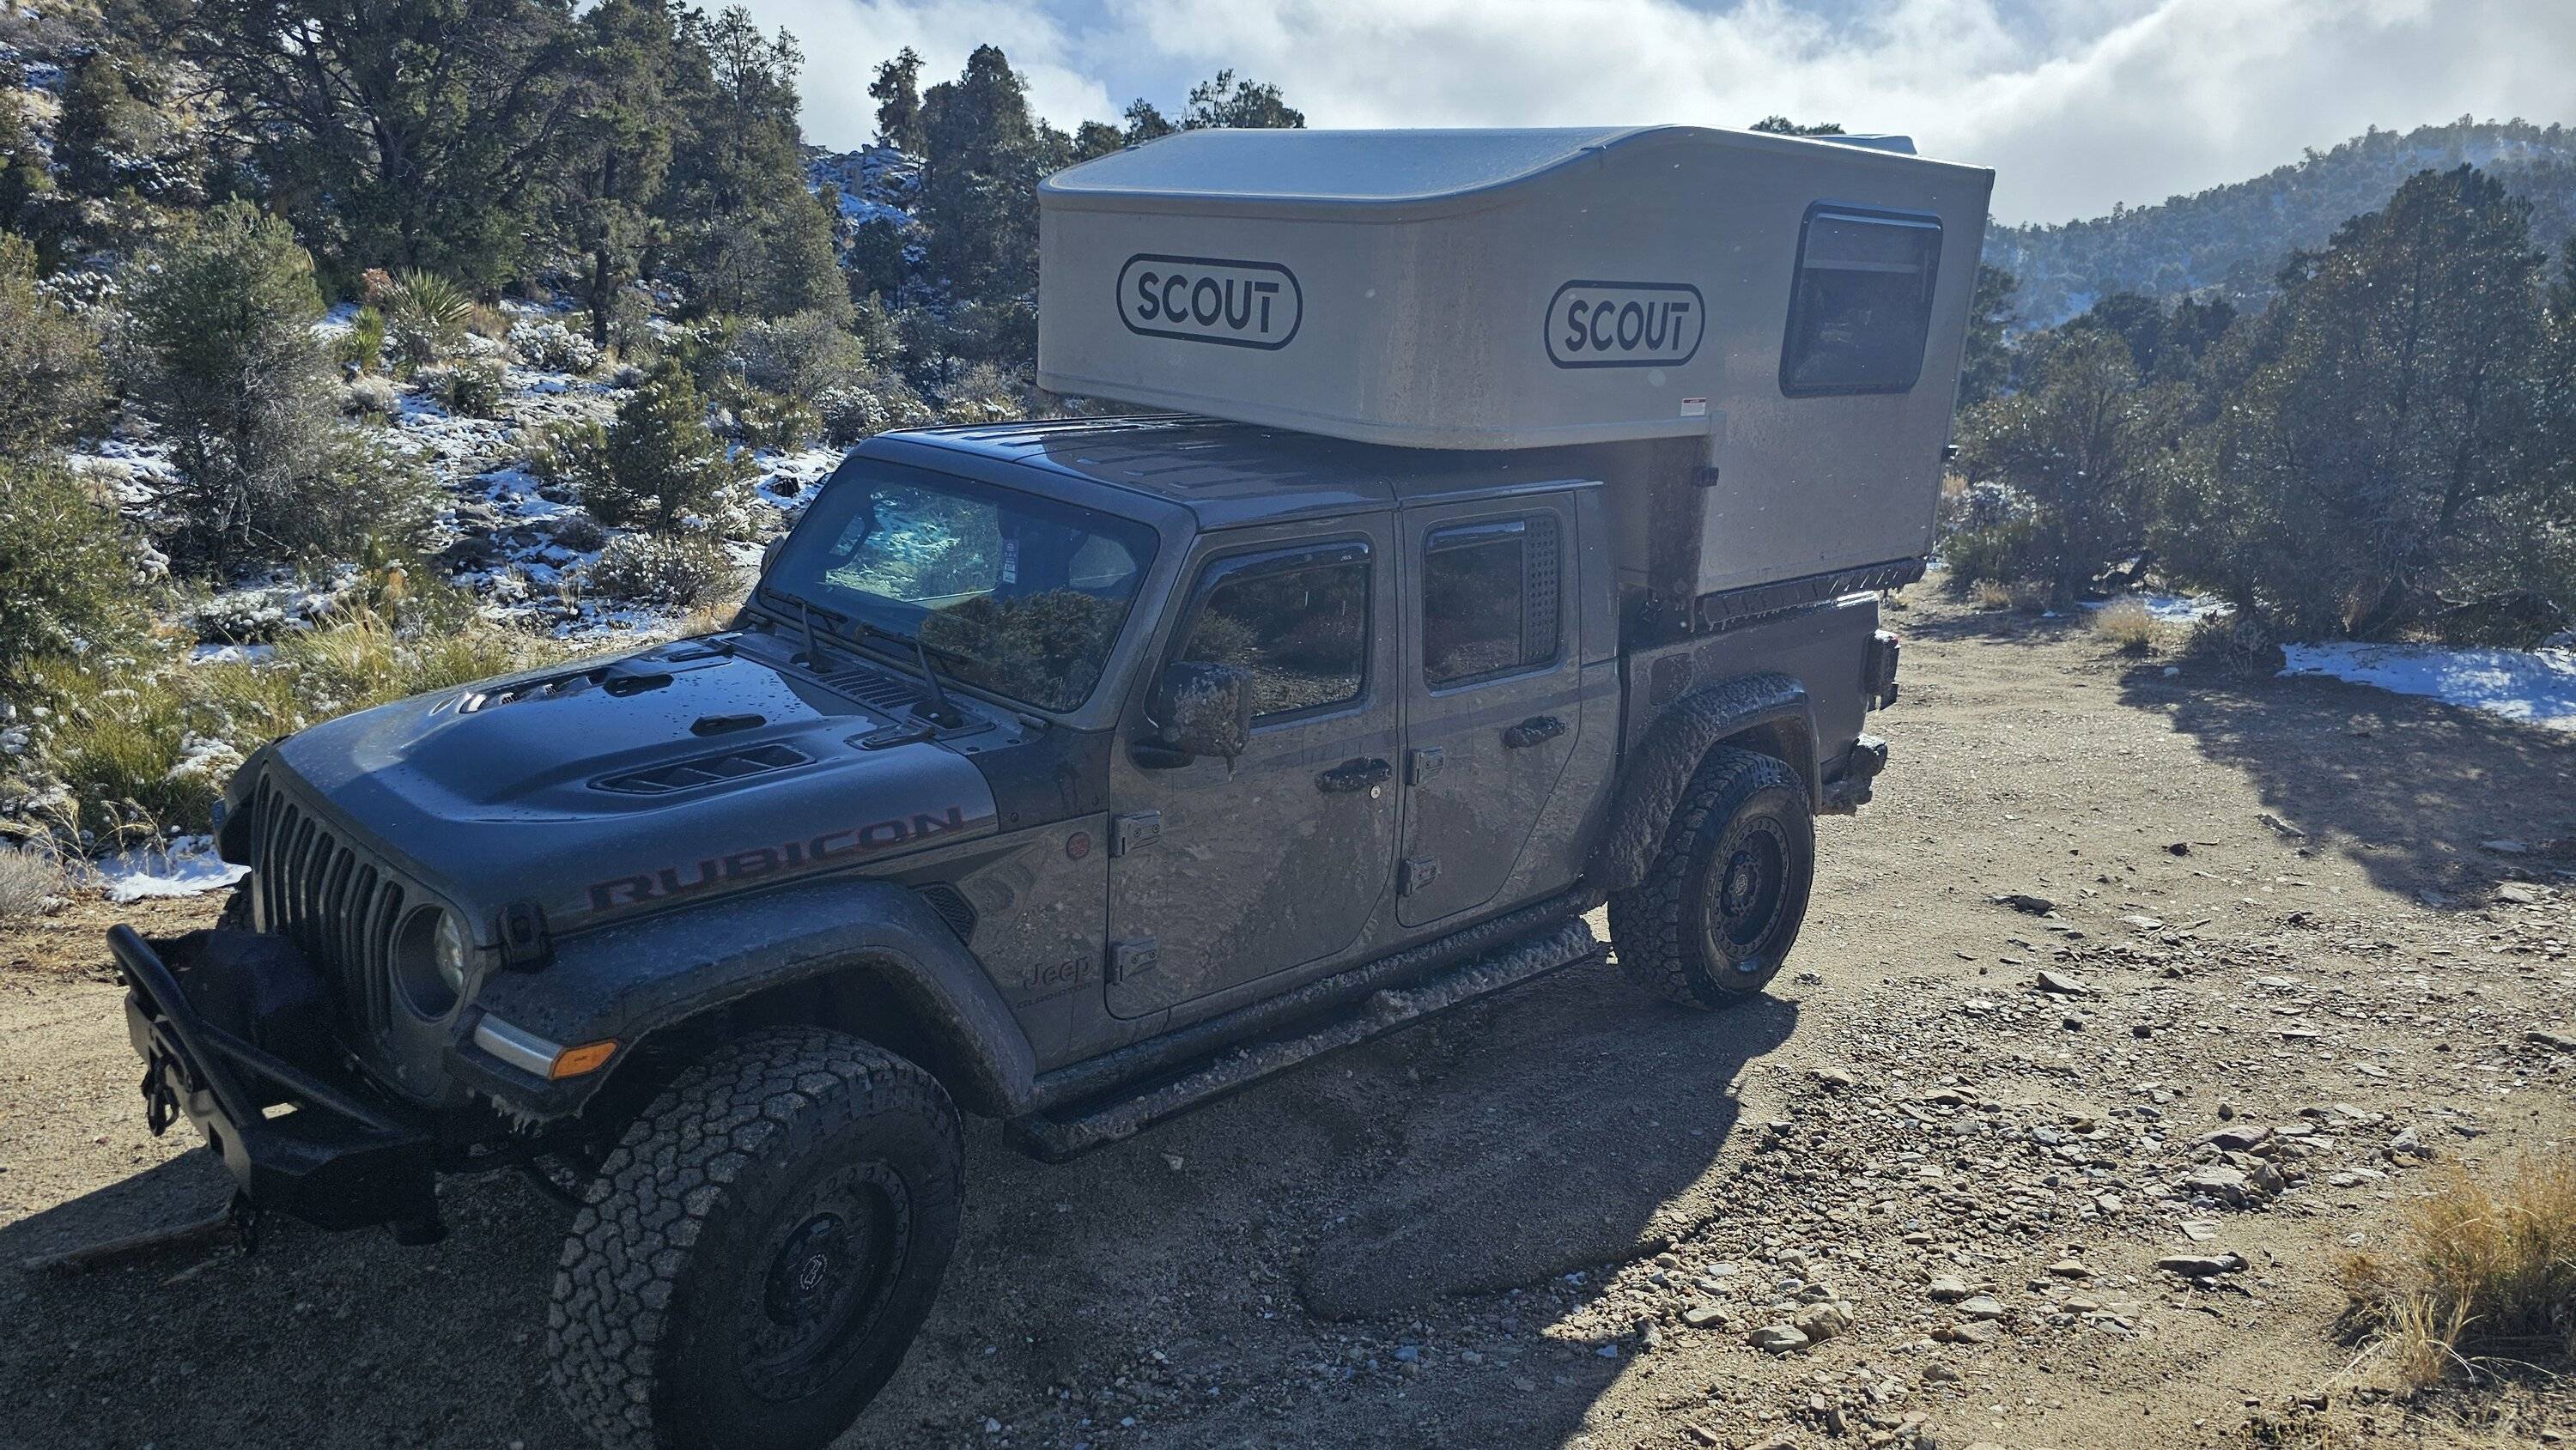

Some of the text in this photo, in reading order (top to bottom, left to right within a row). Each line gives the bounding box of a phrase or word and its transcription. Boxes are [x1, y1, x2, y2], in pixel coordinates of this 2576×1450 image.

[1137, 271, 1279, 333] SCOUT
[1564, 300, 1690, 352] SCOUT
[588, 806, 965, 911] RUBICON
[1023, 955, 1094, 992] Jeep
